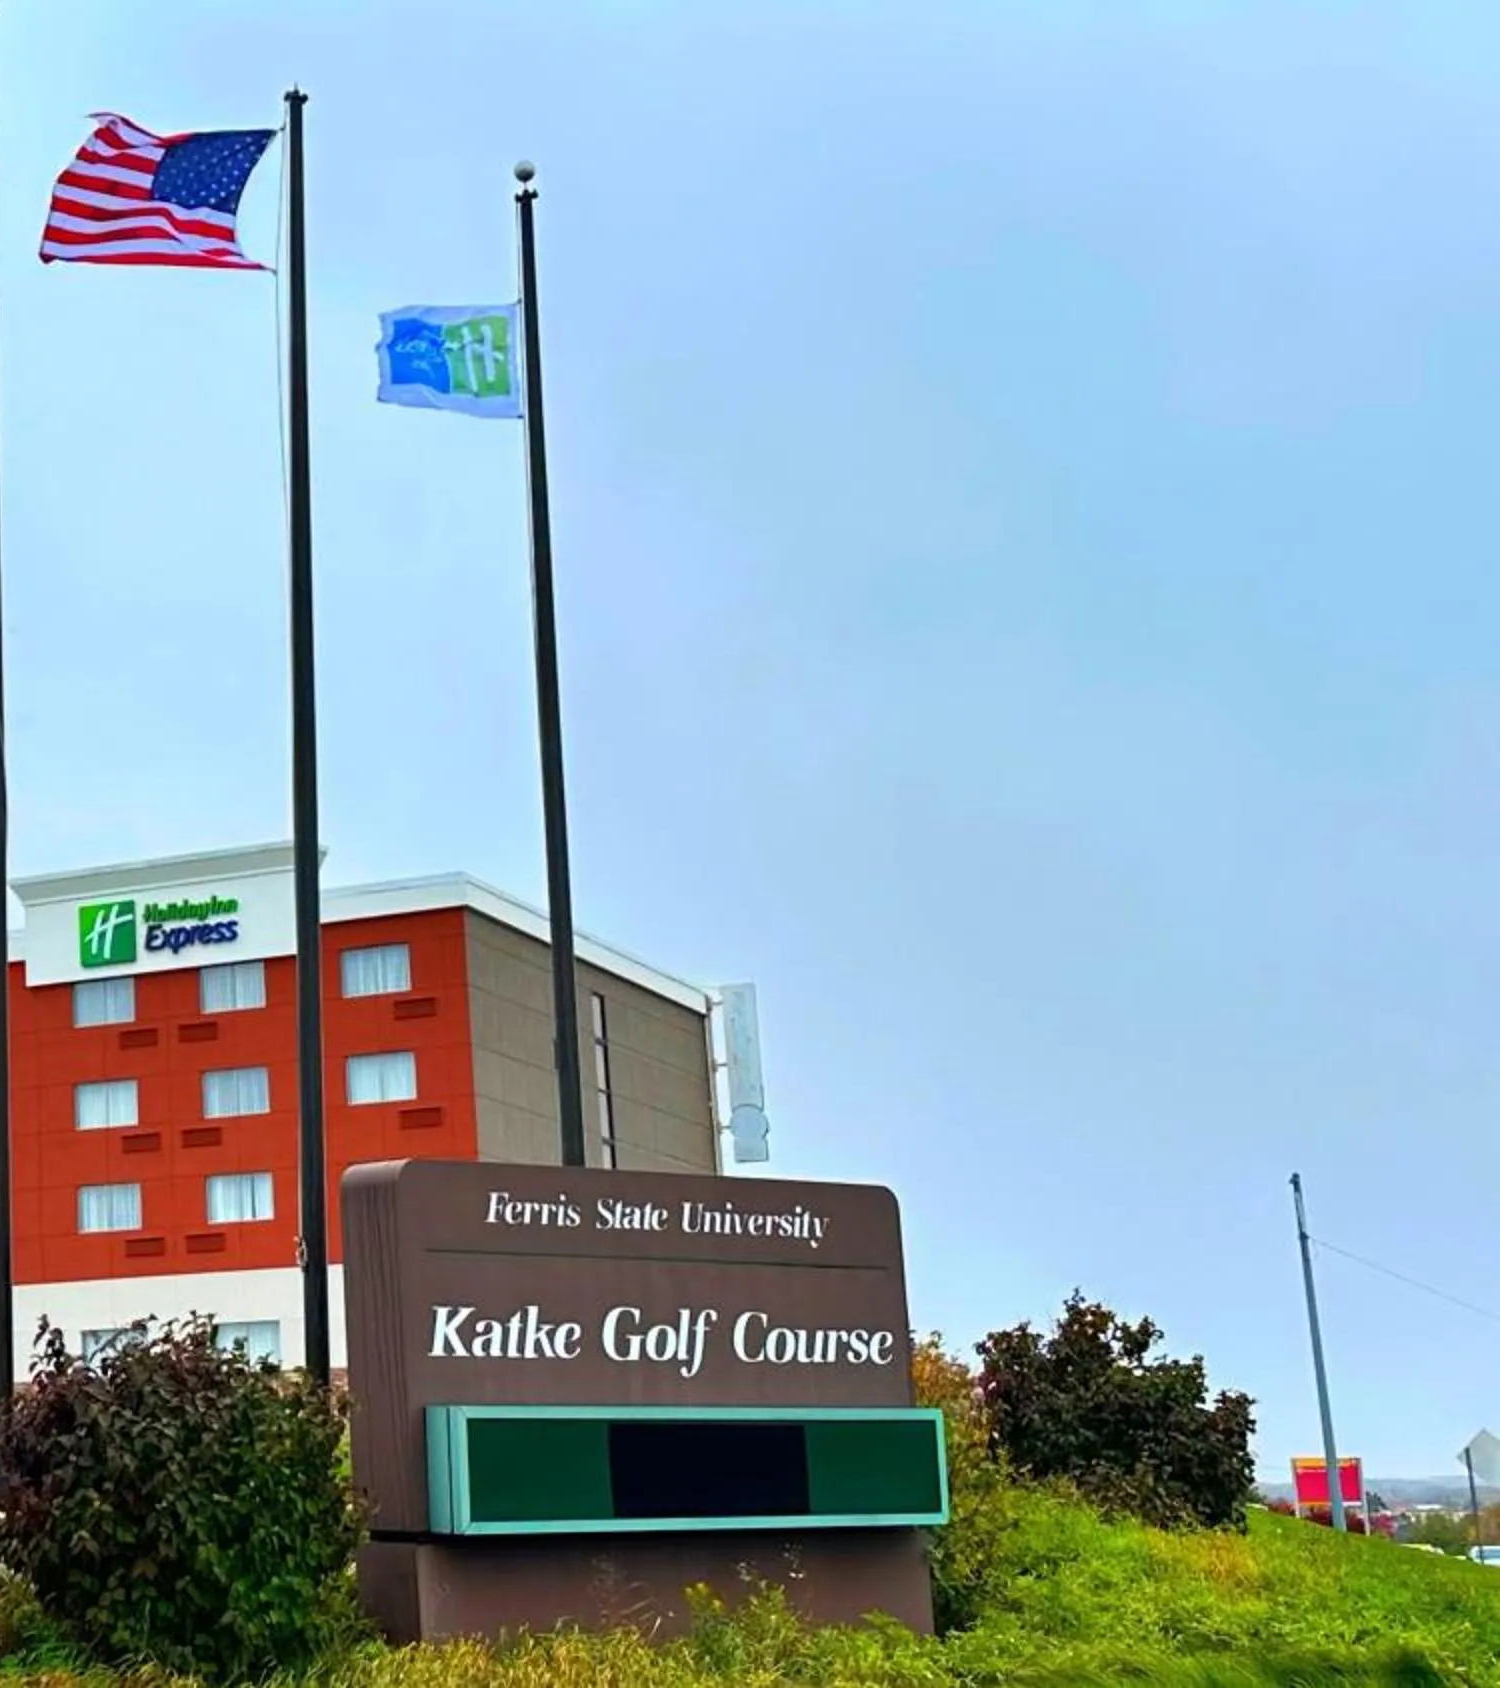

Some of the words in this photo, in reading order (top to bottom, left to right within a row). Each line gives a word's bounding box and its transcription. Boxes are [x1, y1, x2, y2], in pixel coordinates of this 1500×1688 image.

[143, 900, 210, 922] Holiday
[145, 920, 238, 954] Express
[485, 1191, 581, 1227] Ferris
[595, 1198, 669, 1232] State
[681, 1202, 829, 1248] University
[427, 1305, 582, 1360] Katke
[602, 1306, 718, 1378] Golf
[733, 1311, 894, 1365] Course
